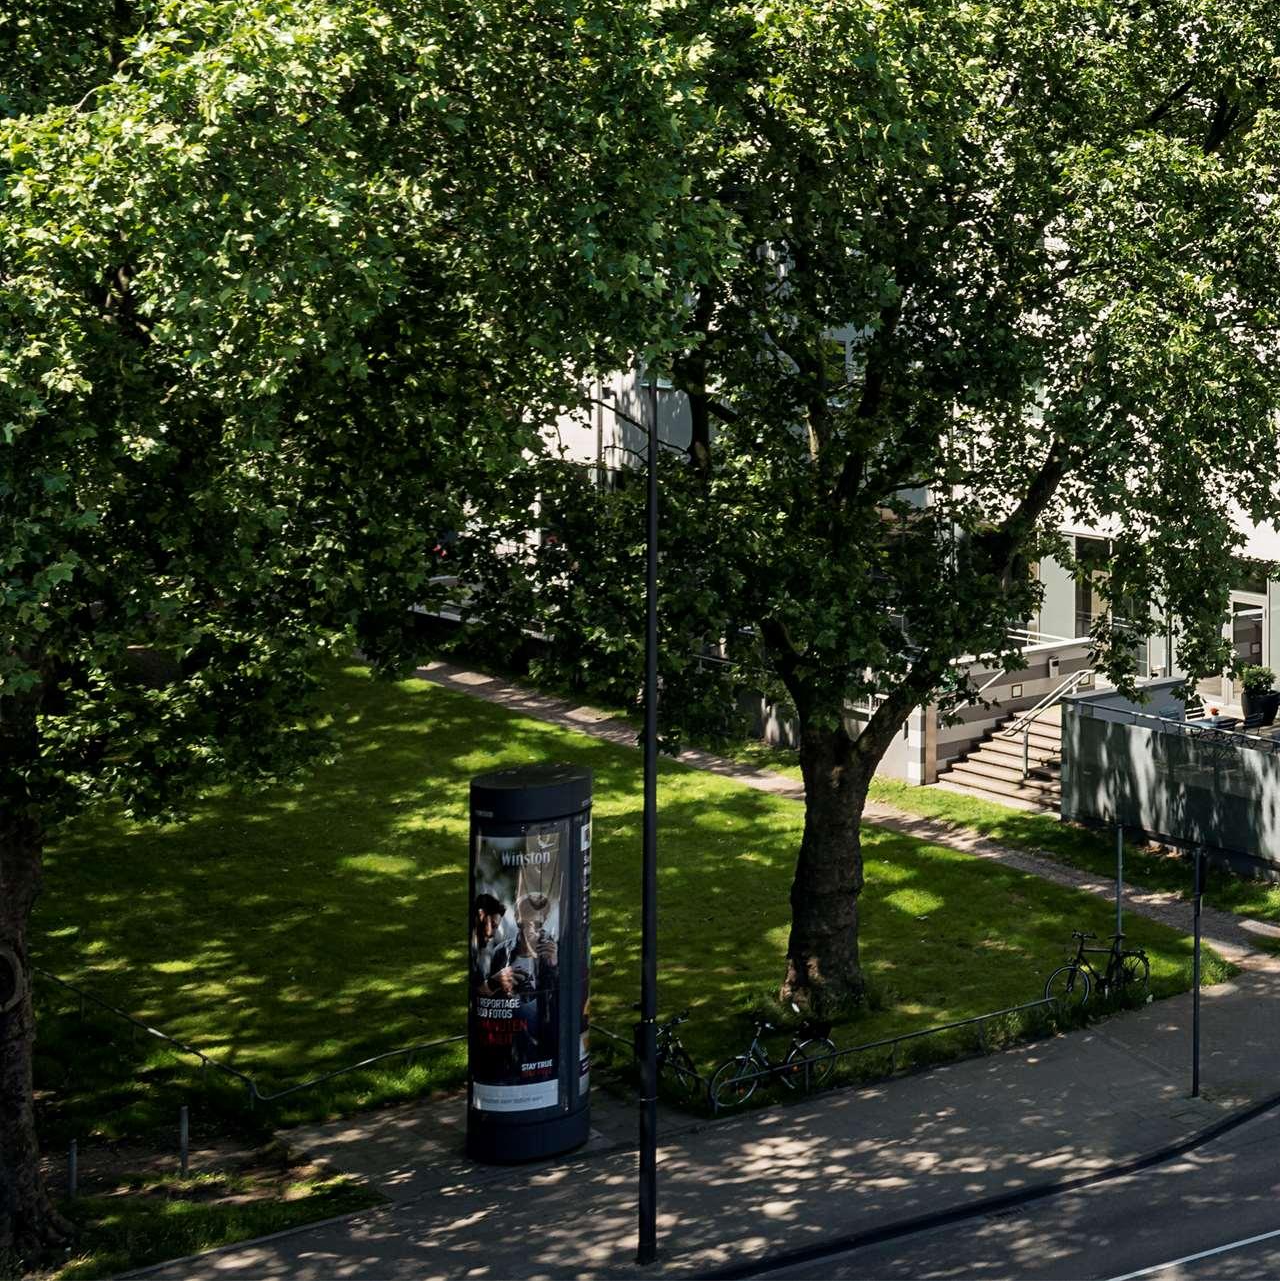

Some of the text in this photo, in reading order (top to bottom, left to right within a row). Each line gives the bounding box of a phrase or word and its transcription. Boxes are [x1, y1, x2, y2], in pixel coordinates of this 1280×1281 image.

[502, 850, 551, 866] Winston
[480, 998, 521, 1009] REPORTAGE
[489, 1008, 513, 1019] FOTOS
[521, 1059, 553, 1072] STAY TRUE
